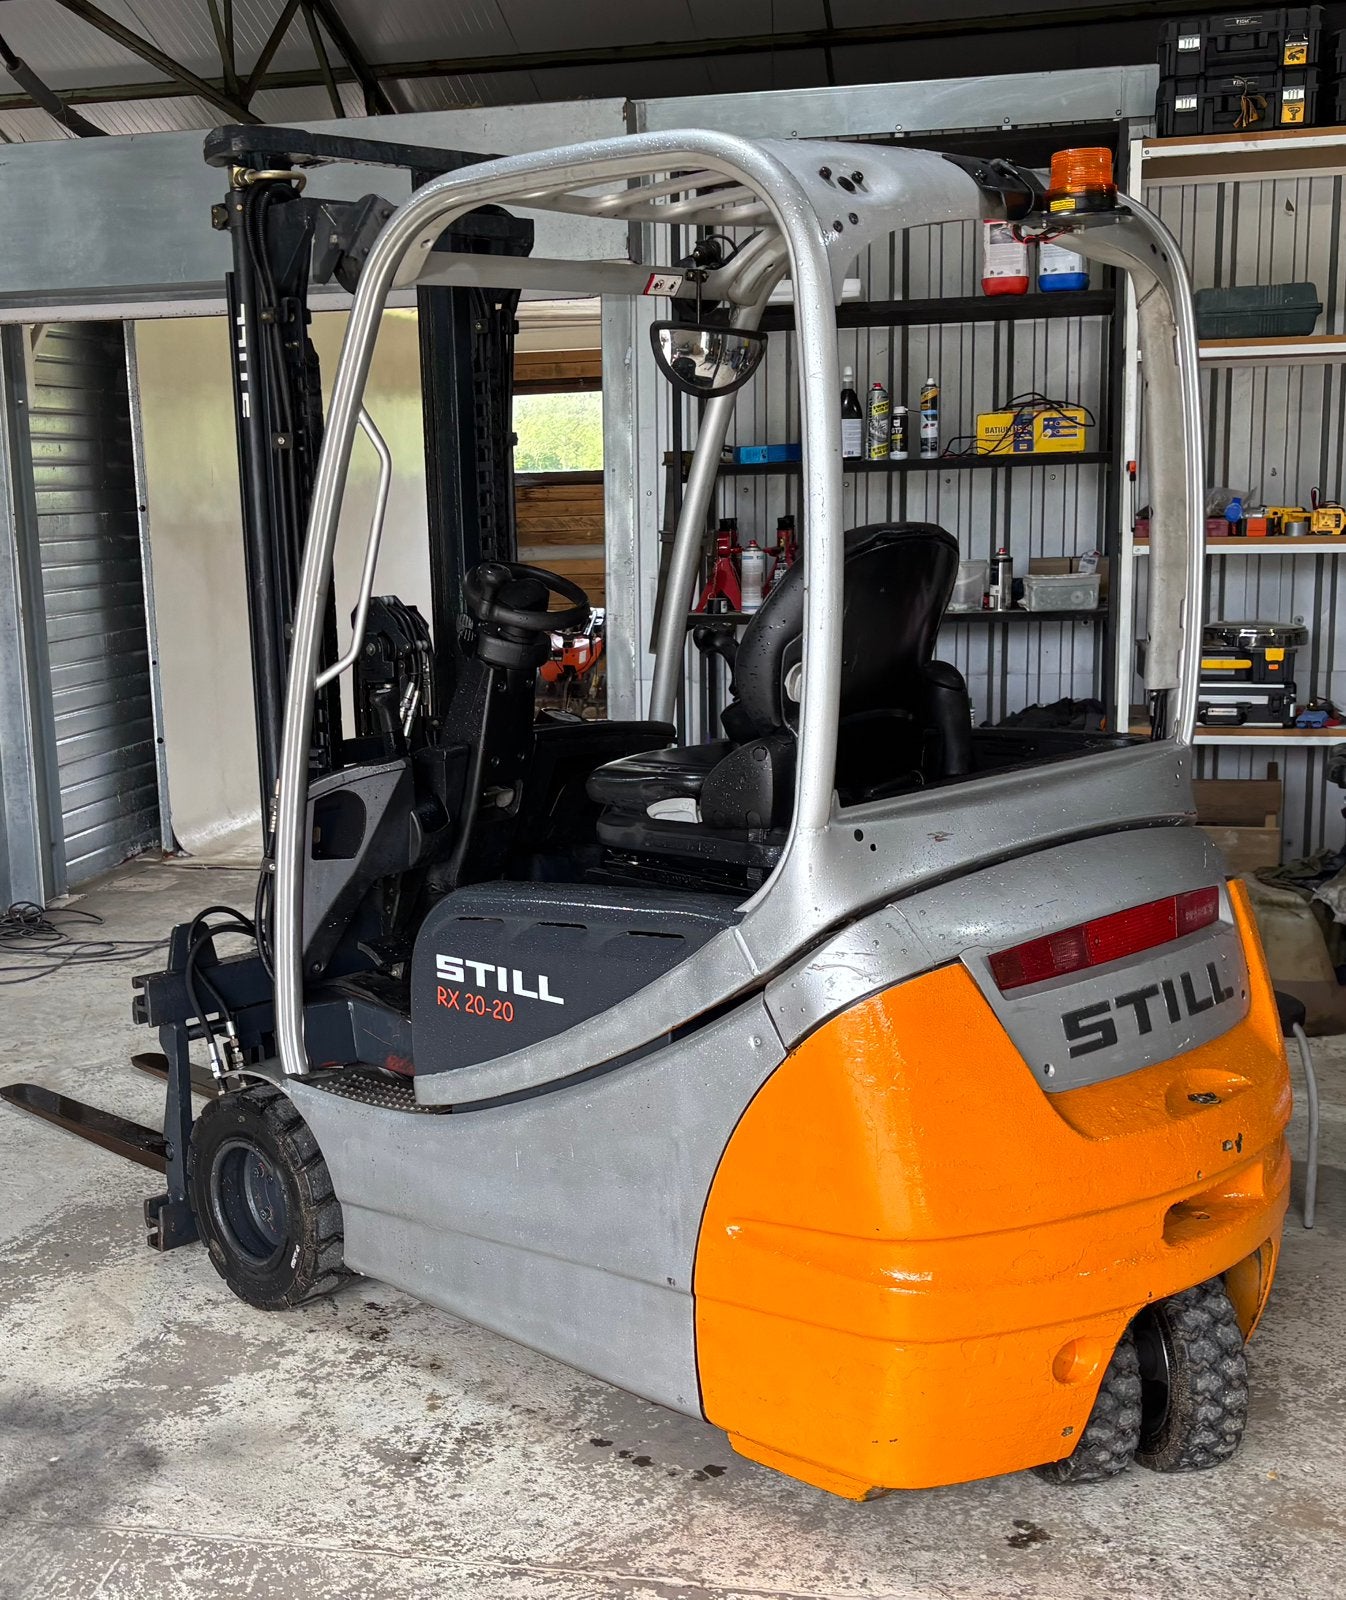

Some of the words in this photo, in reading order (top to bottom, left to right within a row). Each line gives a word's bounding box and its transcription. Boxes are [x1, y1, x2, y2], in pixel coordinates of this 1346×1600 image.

[436, 953, 565, 1005] STILL
[437, 985, 461, 1011] RX
[465, 993, 515, 1023] 20-20
[1060, 961, 1235, 1059] STILL
